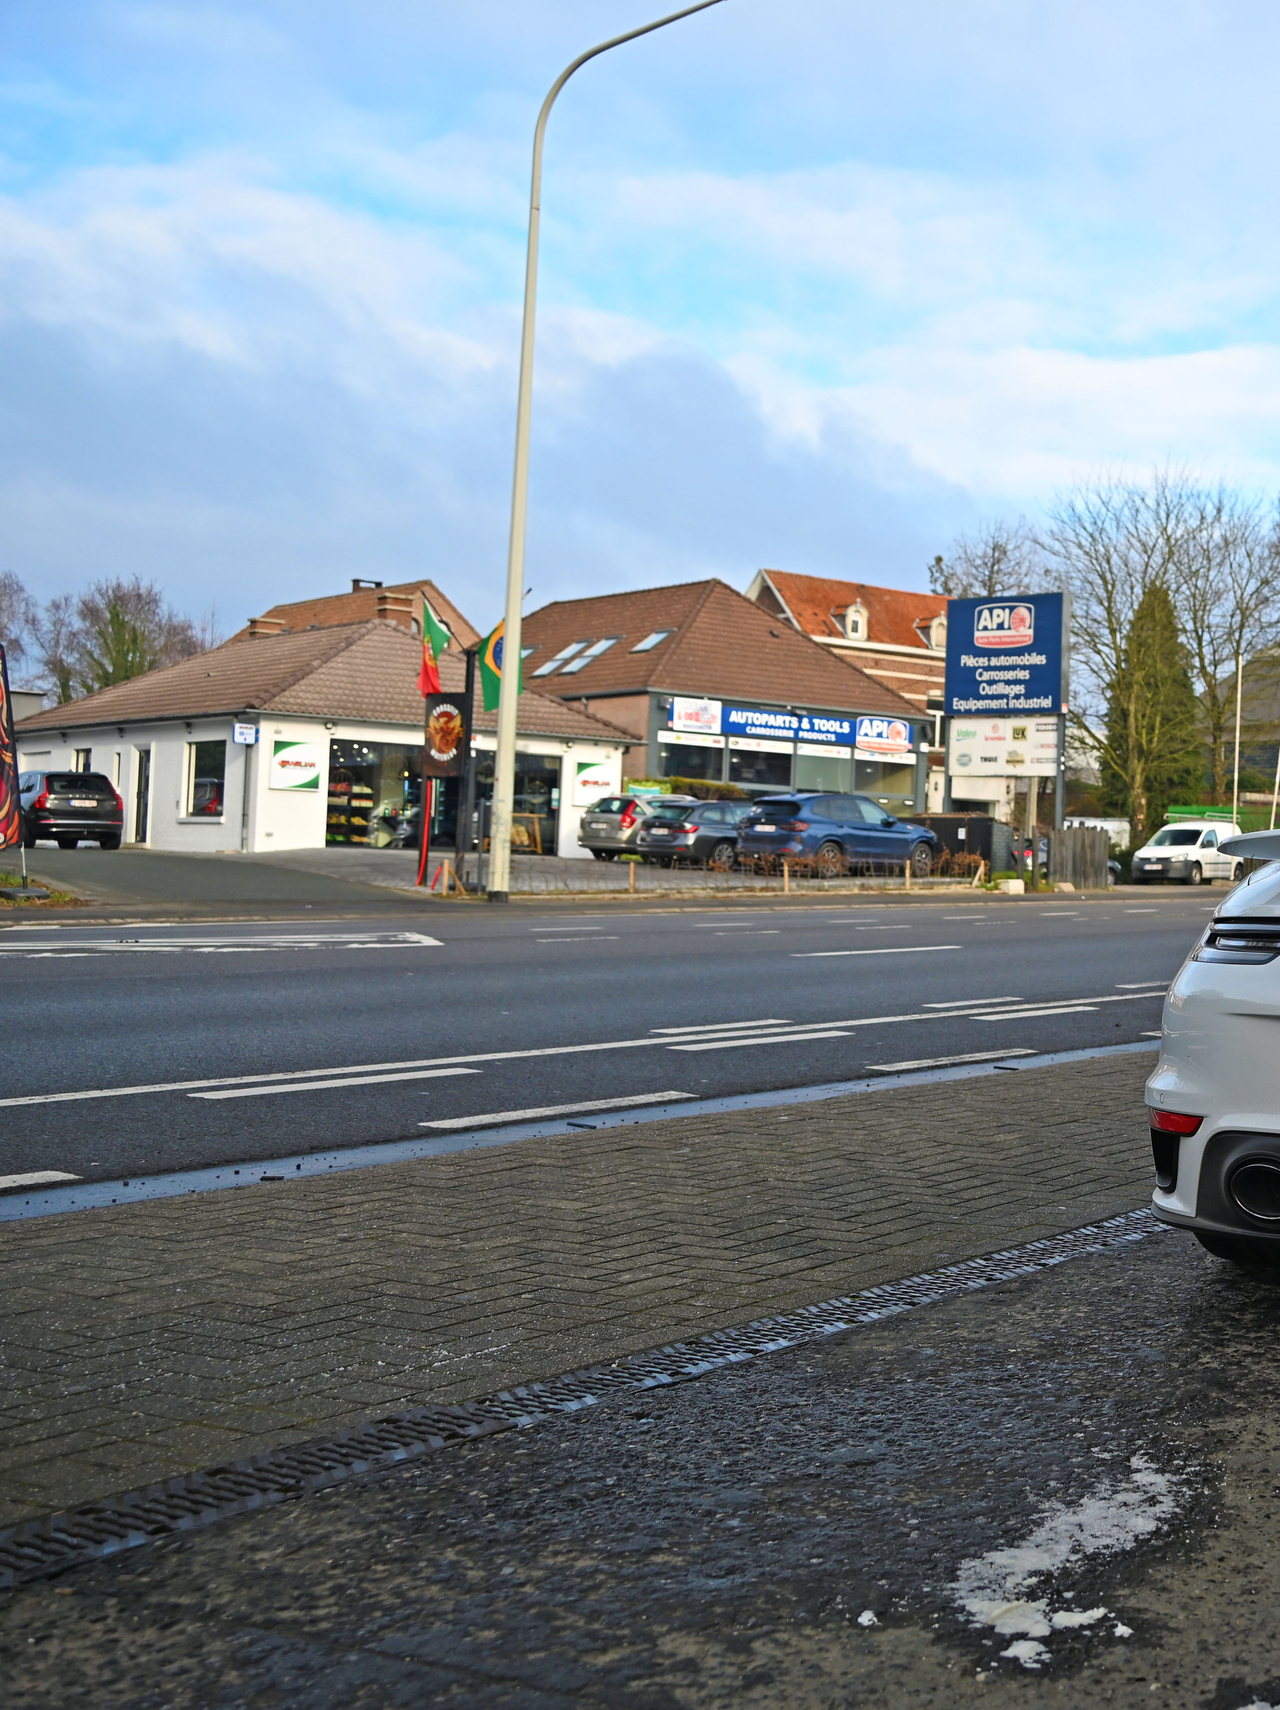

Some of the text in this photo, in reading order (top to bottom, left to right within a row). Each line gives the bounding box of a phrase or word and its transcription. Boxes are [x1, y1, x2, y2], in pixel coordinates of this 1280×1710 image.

[977, 608, 1010, 630] API
[960, 652, 1047, 667] Pièces automobiles
[975, 668, 1030, 681] Carrosseries
[979, 682, 1026, 697] Outillages
[952, 695, 1053, 712] Equipement industriel
[729, 710, 799, 729] AUTOPARTS
[801, 718, 811, 730] &
[812, 718, 850, 734] TOOLS
[859, 719, 888, 737] API
[746, 726, 836, 742] CARROSSERIE PRODUCTS
